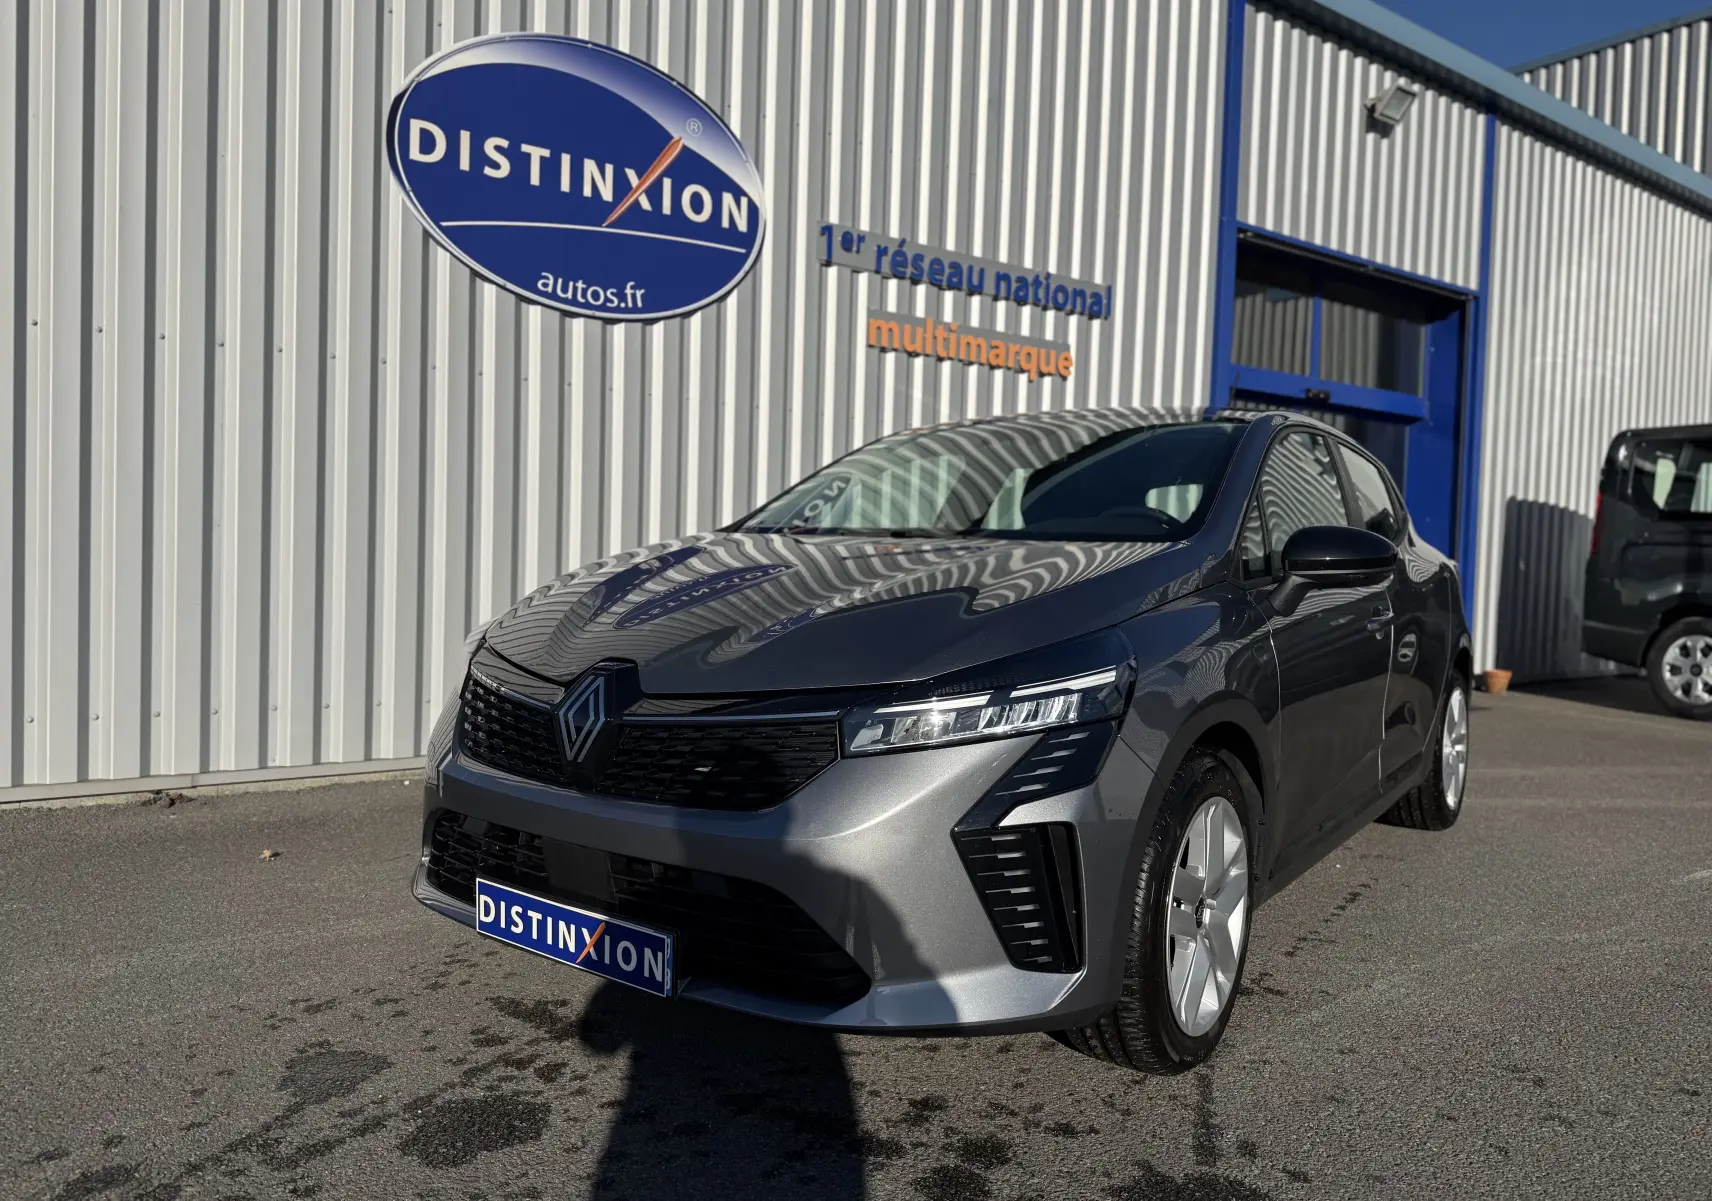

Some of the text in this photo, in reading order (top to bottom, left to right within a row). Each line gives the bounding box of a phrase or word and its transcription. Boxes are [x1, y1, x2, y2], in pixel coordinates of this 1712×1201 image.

[408, 118, 749, 233] DISTINXION
[536, 271, 646, 309] autos.fr
[820, 224, 1112, 319] 1er réseau national
[868, 318, 1074, 382] multimarque
[479, 894, 663, 982] DISTINXION
